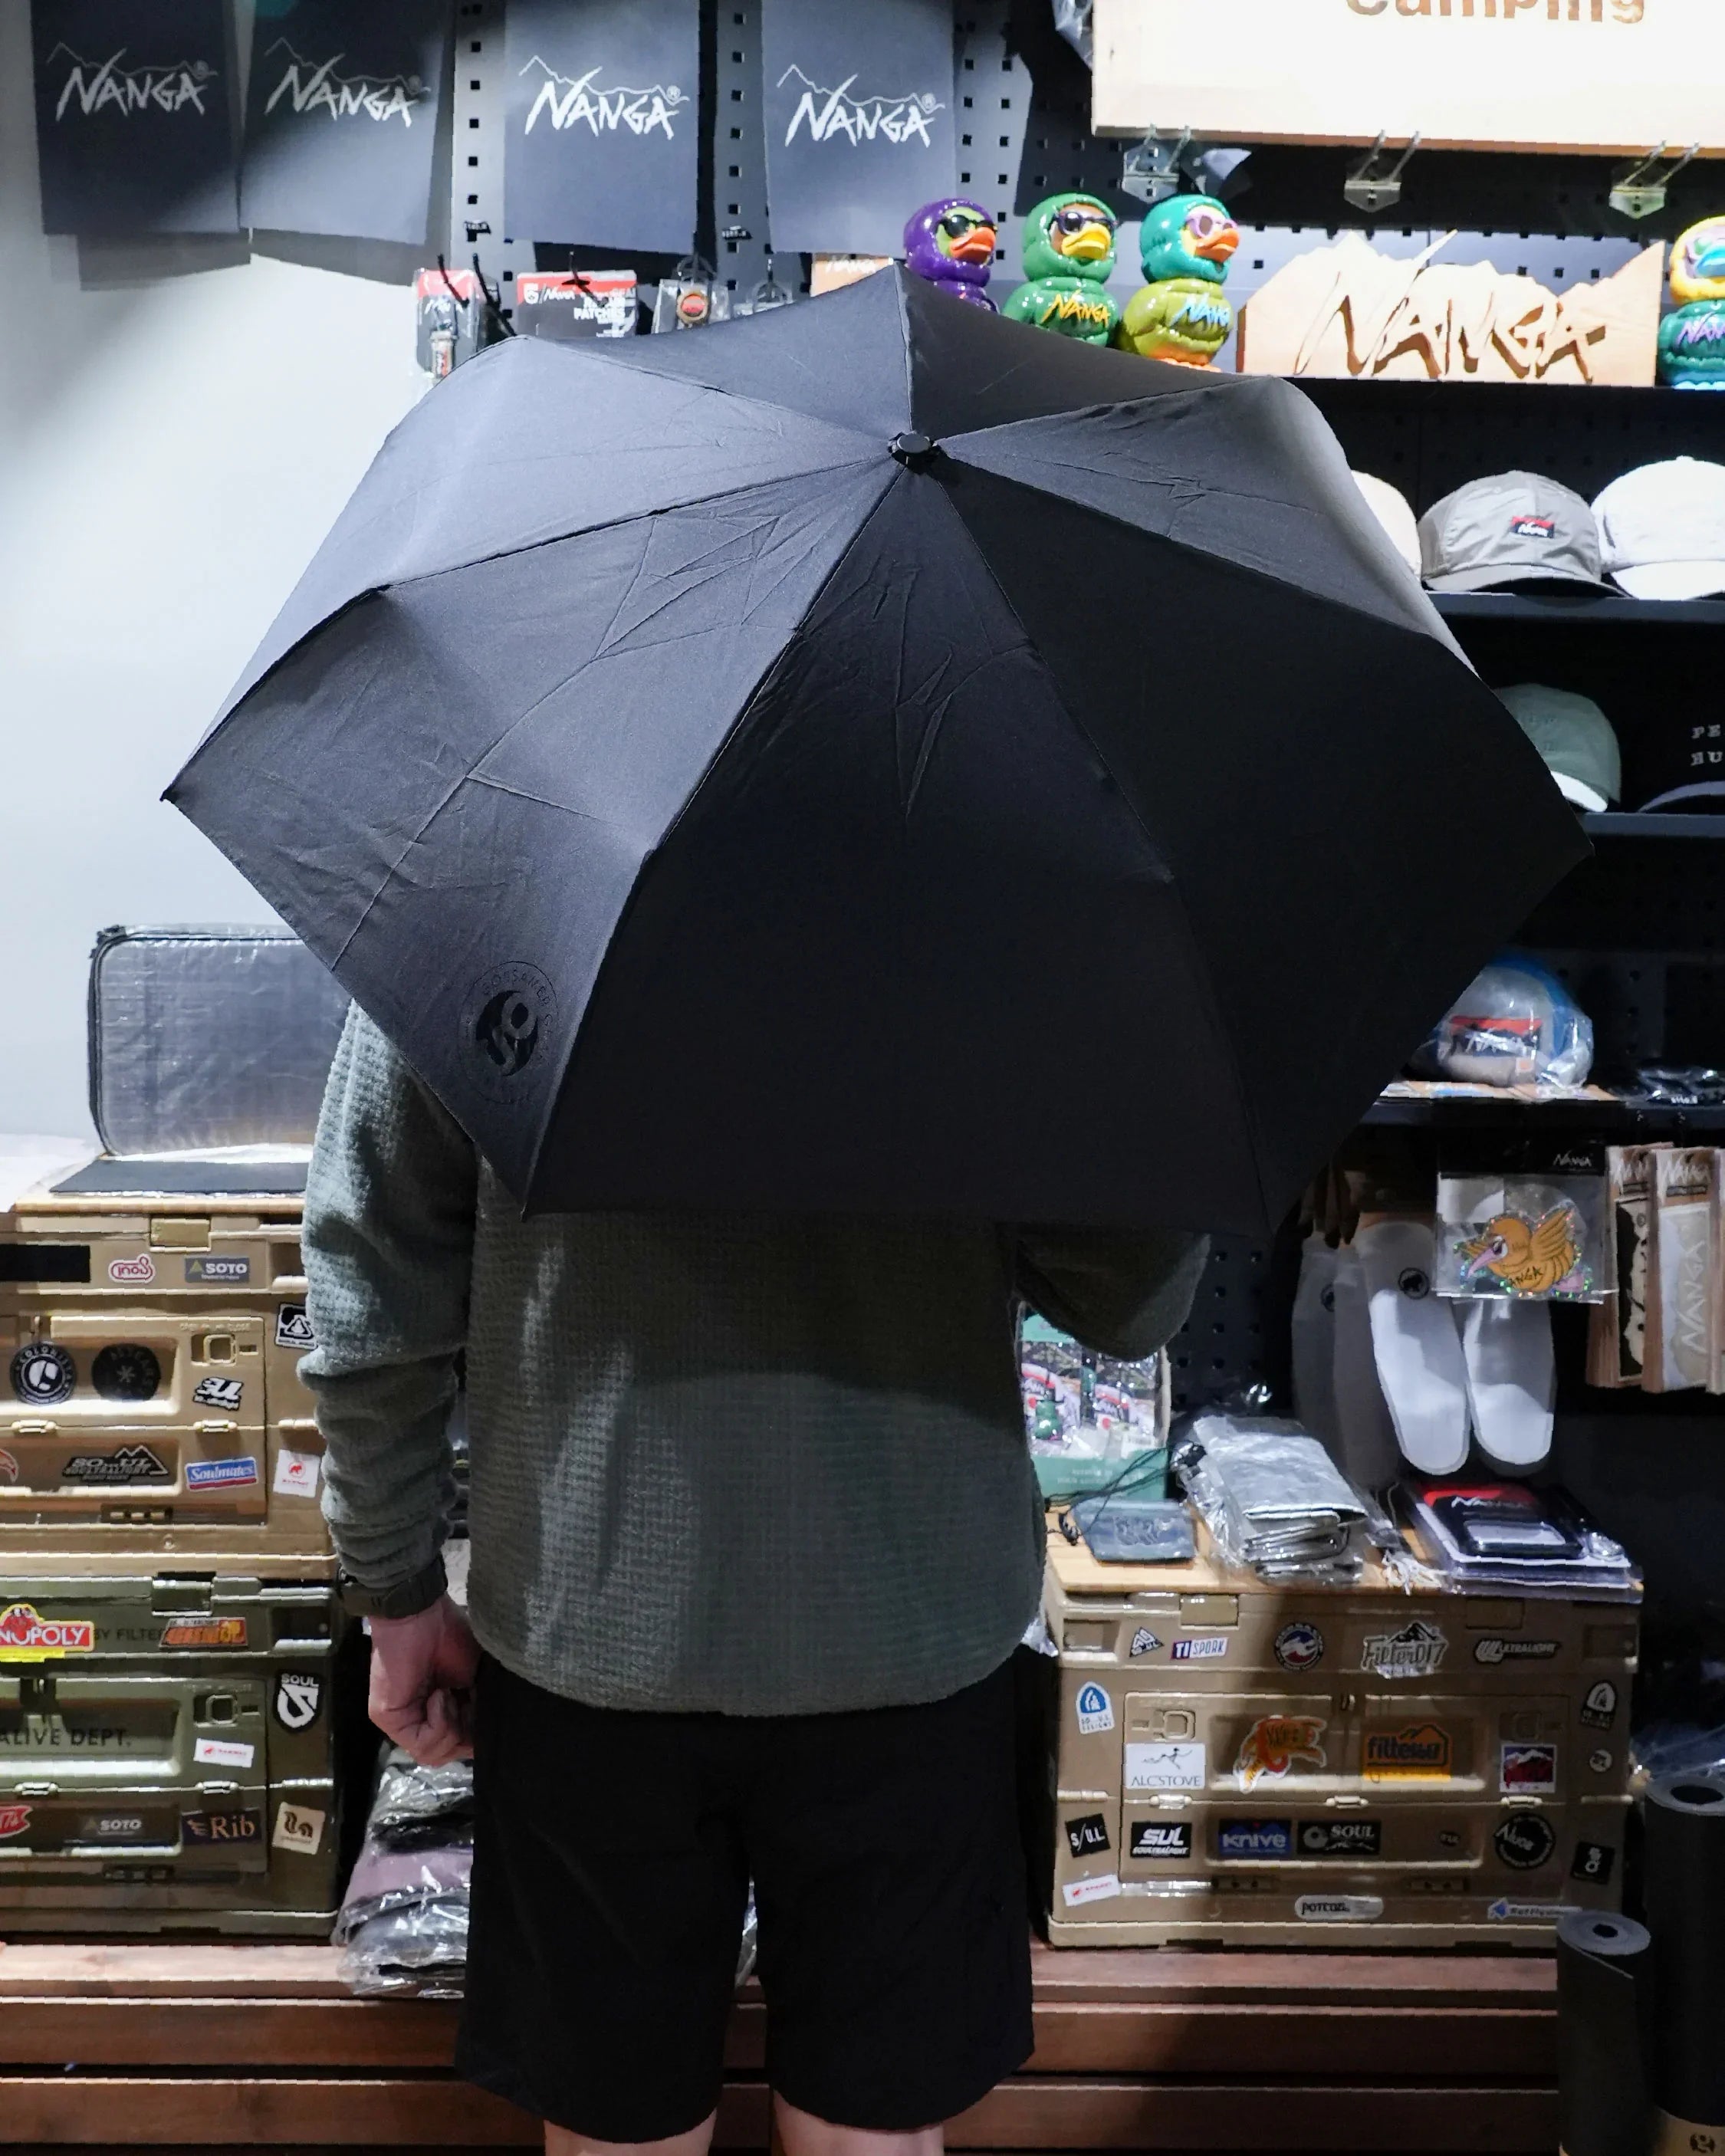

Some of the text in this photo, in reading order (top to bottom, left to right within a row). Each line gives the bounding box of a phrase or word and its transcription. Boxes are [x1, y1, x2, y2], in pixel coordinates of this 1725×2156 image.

[55, 48, 209, 123] NANGA
[264, 53, 419, 129] NANGA
[525, 66, 679, 140] NANGA
[785, 74, 935, 147] NANGA
[1042, 288, 1111, 325] NANGA
[1293, 230, 1607, 384] NANGA
[205, 1263, 248, 1275] SOTO
[191, 1465, 254, 1481] Soulmates
[1175, 1639, 1224, 1658] TI SPORK
[281, 1673, 320, 1688] SOUL
[100, 1819, 143, 1831] SOTO
[209, 1814, 256, 1839] Rib
[1330, 1824, 1375, 1839] SOUL
